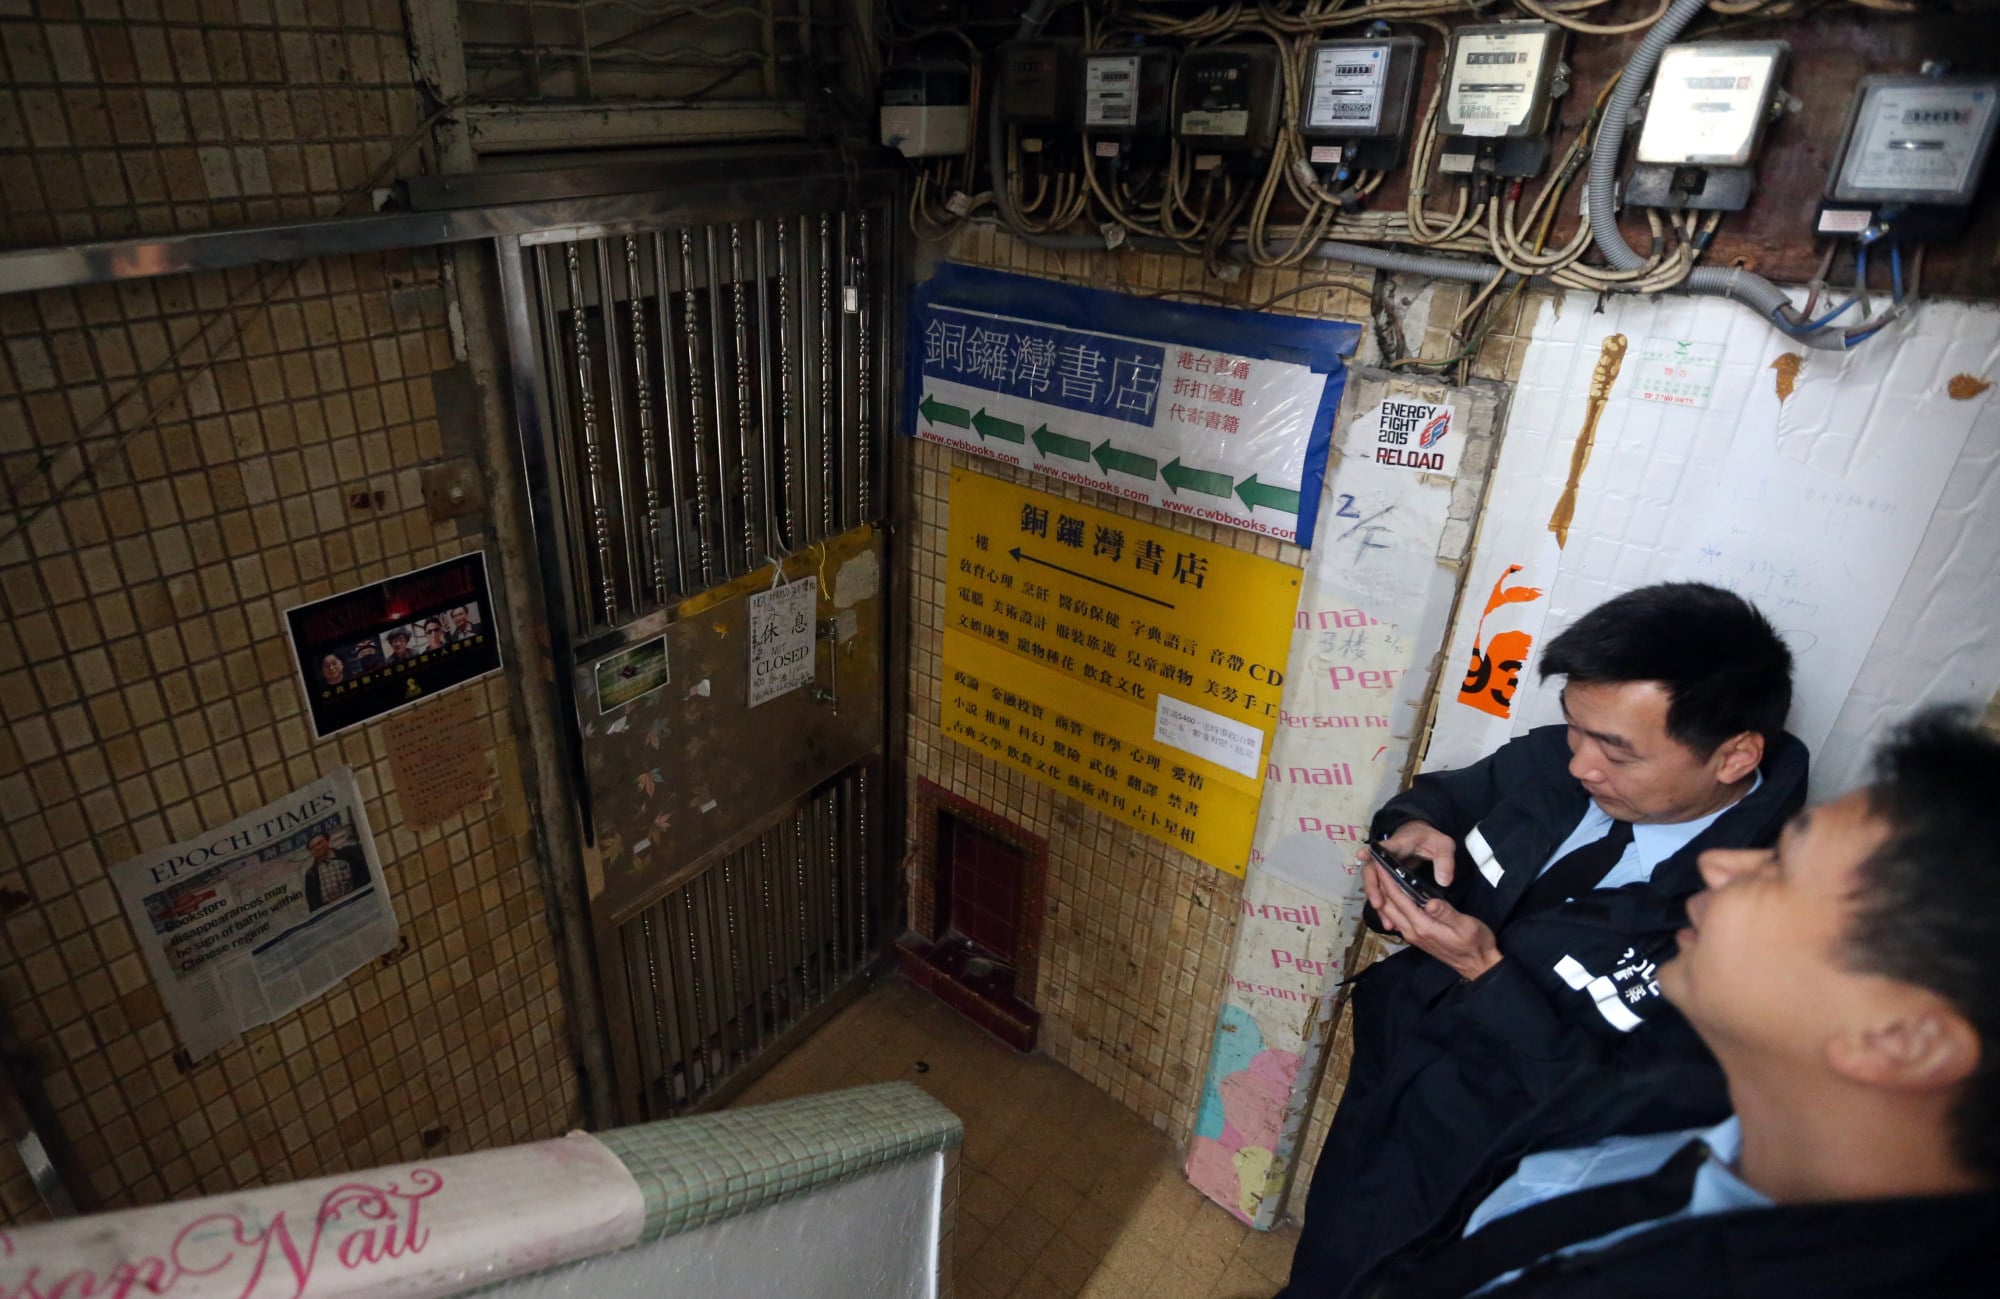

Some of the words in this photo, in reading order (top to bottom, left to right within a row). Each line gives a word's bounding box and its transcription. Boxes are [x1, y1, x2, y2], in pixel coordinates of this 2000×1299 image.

[924, 317, 1162, 416] 銅鑼灣書店
[1177, 350, 1252, 381] 港台書籍
[1174, 377, 1246, 408] 折扣優惠
[1381, 401, 1437, 420] ENERGY
[1169, 403, 1241, 434] 代寄書籍
[1379, 415, 1420, 432] FIGHT
[922, 429, 1020, 465] www.cwbbooks.com
[1378, 430, 1409, 446] 2015
[1376, 446, 1444, 471] RELOAD
[1033, 461, 1149, 503] www.cwbbooks.com
[1020, 502, 1210, 590] 銅鑼灣書店
[762, 611, 807, 645] 休息
[1130, 619, 1200, 657] 字典語言
[756, 645, 810, 676] CLOSED
[771, 642, 788, 656] NOT
[956, 613, 1011, 645] 文娛康樂
[1017, 636, 1075, 671] 寵物種花
[1083, 663, 1146, 700] 飲食文化
[957, 586, 984, 608] 電腦
[991, 599, 1048, 632] 美術設計
[1056, 624, 1118, 658] 服裝旅遊
[1127, 650, 1194, 688] 兒童讀物
[1203, 677, 1278, 719] 美勞手工
[1461, 647, 1523, 707] 93
[954, 671, 980, 693] 政論
[991, 686, 1044, 720] 金融投資
[1055, 715, 1084, 738] 商管
[1093, 729, 1122, 753] 哲學
[1130, 745, 1162, 773] 心理
[1172, 764, 1205, 792] 愛情
[1279, 710, 1359, 728] Person
[985, 708, 1011, 731] 推理
[1018, 723, 1046, 747] 科幻
[1051, 739, 1081, 763] 驚險
[1089, 756, 1119, 781] 武俠
[1127, 773, 1159, 798] 翻譯
[1168, 792, 1201, 819] 禁書
[1288, 762, 1353, 786] nail
[951, 719, 1002, 751] 古典文學
[1006, 744, 1061, 781] 飲食文化
[1067, 774, 1126, 813] 藝術書刊
[1131, 803, 1196, 845] 占卜星相
[149, 829, 252, 884] EPOCH
[257, 790, 337, 839] TIMES
[164, 897, 227, 933] Bookstore
[170, 896, 264, 946] disappearances
[264, 883, 288, 903] may
[174, 943, 193, 960] be
[194, 933, 220, 955] sign
[220, 924, 234, 941] of
[234, 910, 269, 937] battle
[269, 889, 303, 915] within
[1262, 903, 1321, 927] nail
[181, 943, 230, 973] Chinese
[231, 922, 271, 949] regime
[1227, 972, 1297, 1001] Person
[171, 1168, 443, 1299] Nail
